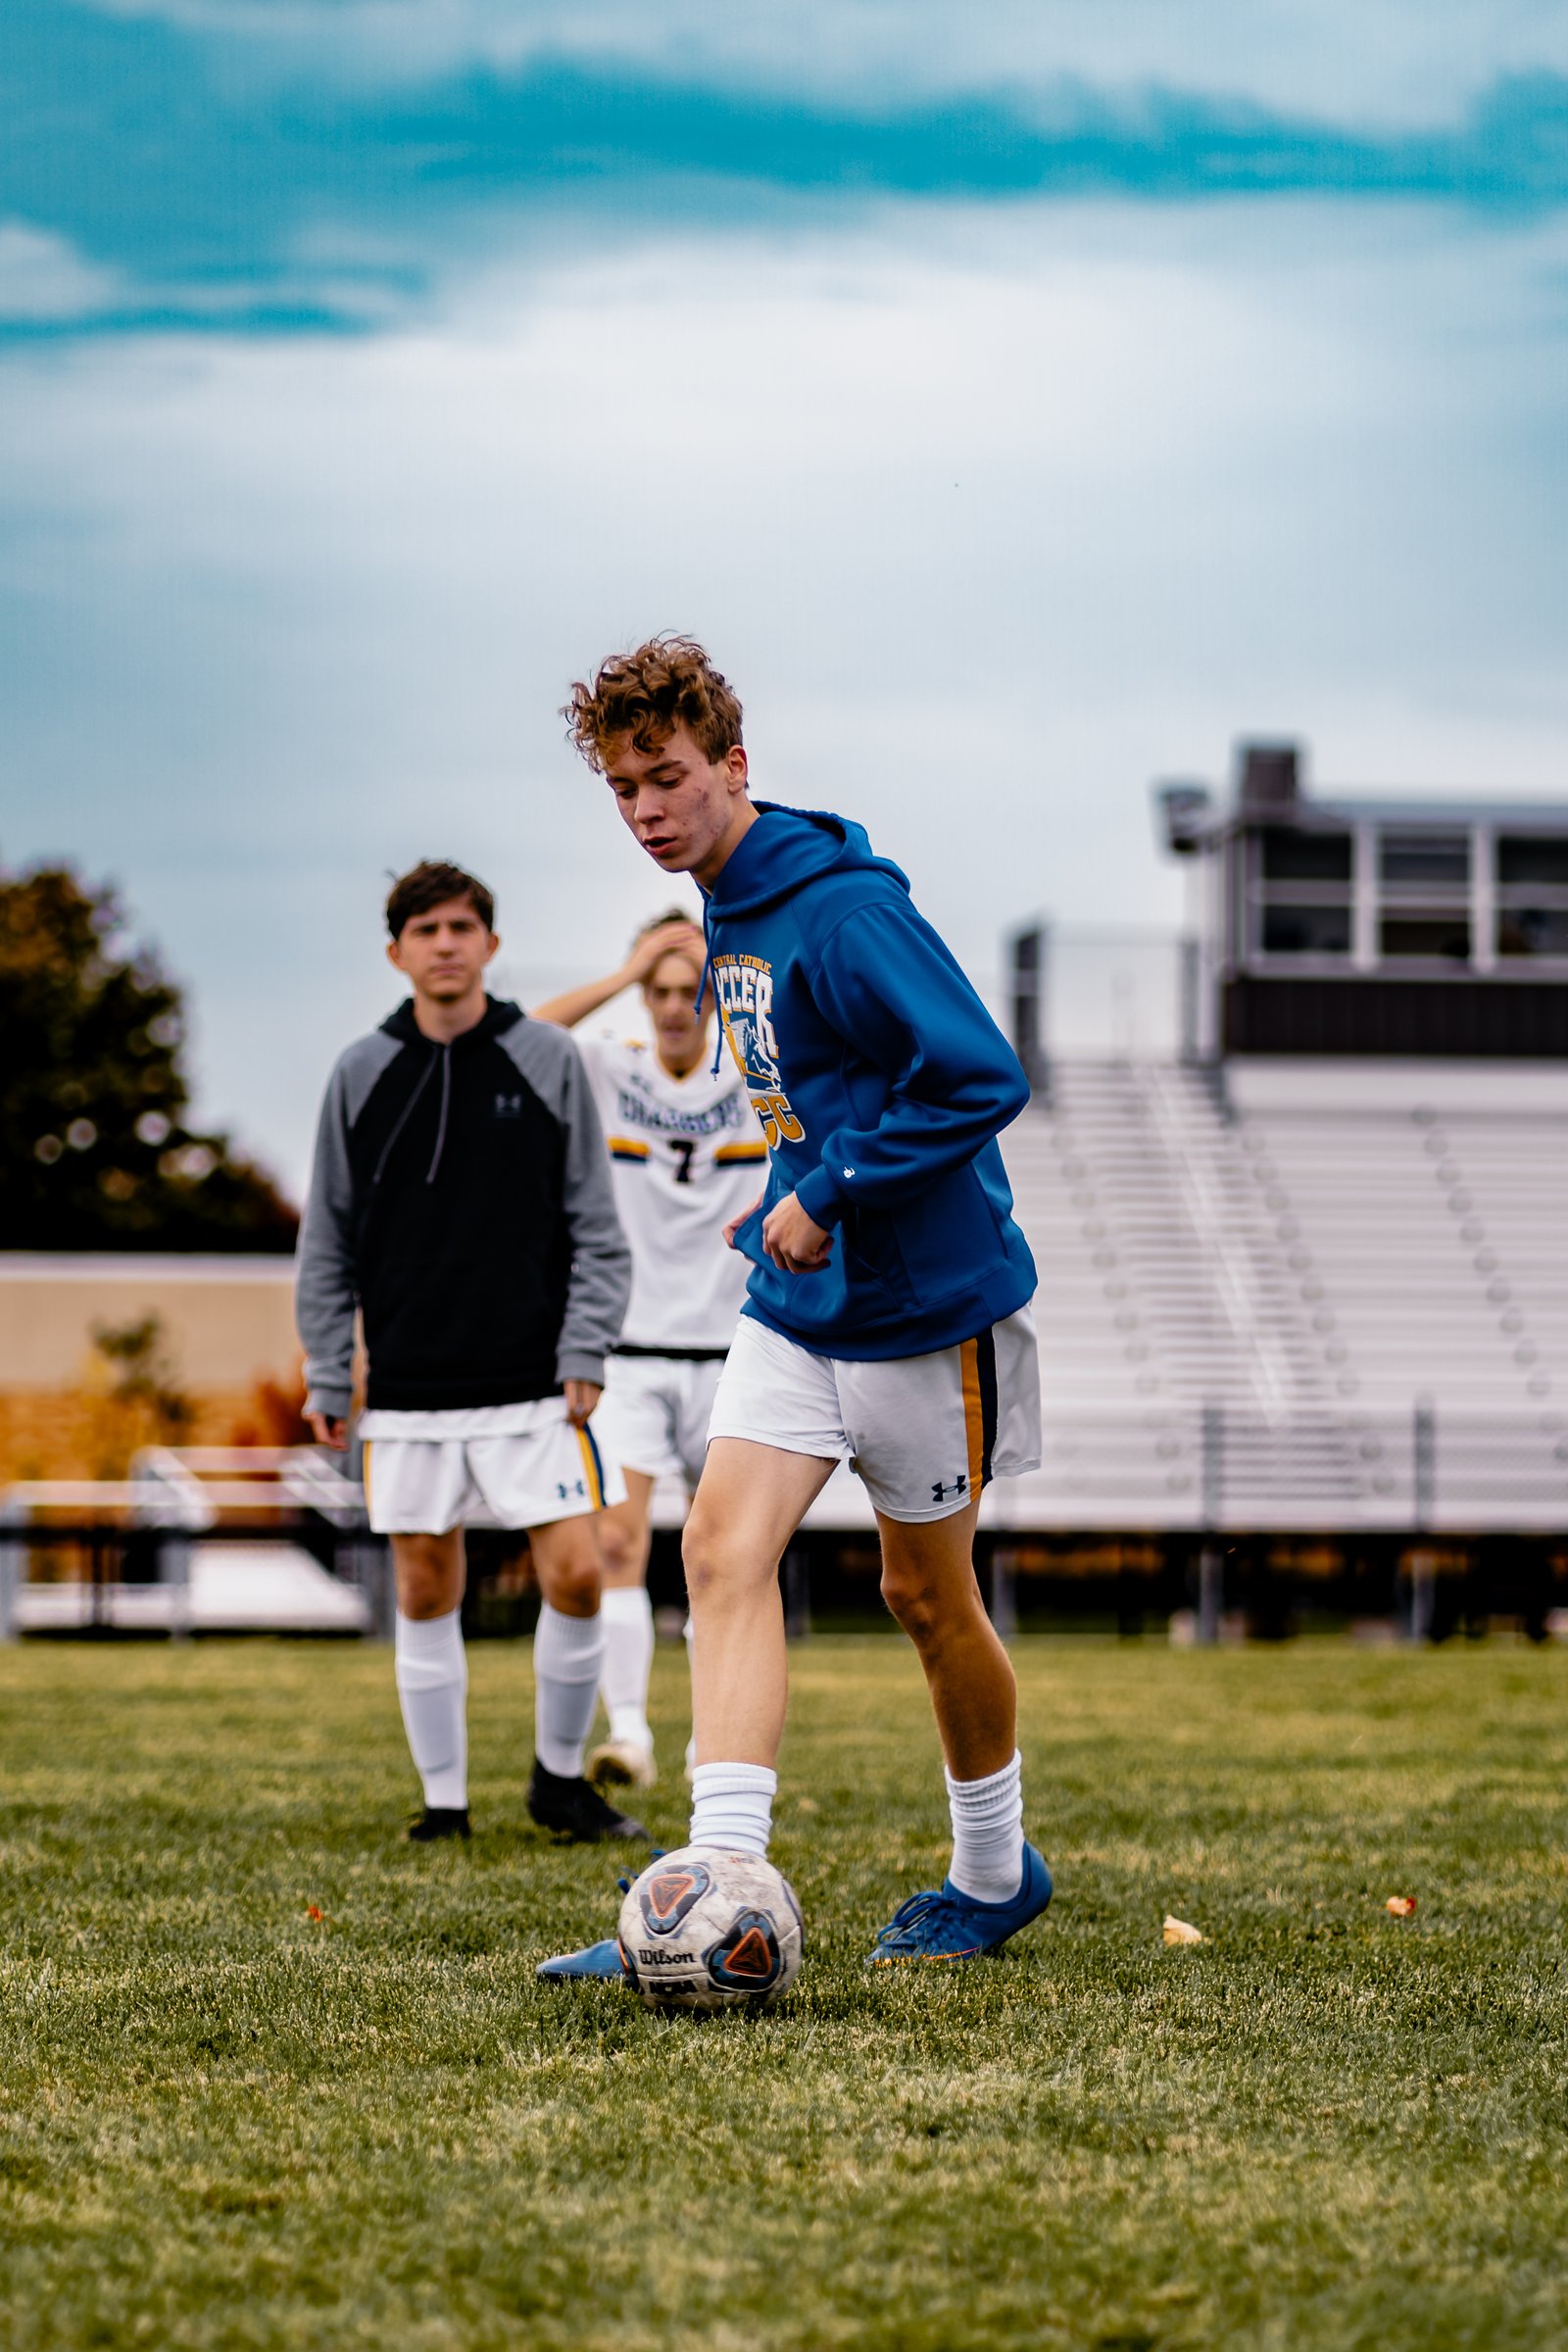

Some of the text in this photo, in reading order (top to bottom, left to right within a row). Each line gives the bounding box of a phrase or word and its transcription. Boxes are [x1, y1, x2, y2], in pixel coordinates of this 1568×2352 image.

[712, 954, 772, 976] CENTRAL CATHOLIC
[713, 965, 779, 1059] CCER
[667, 1139, 695, 1183] 7
[638, 1949, 697, 1965] Wilson
